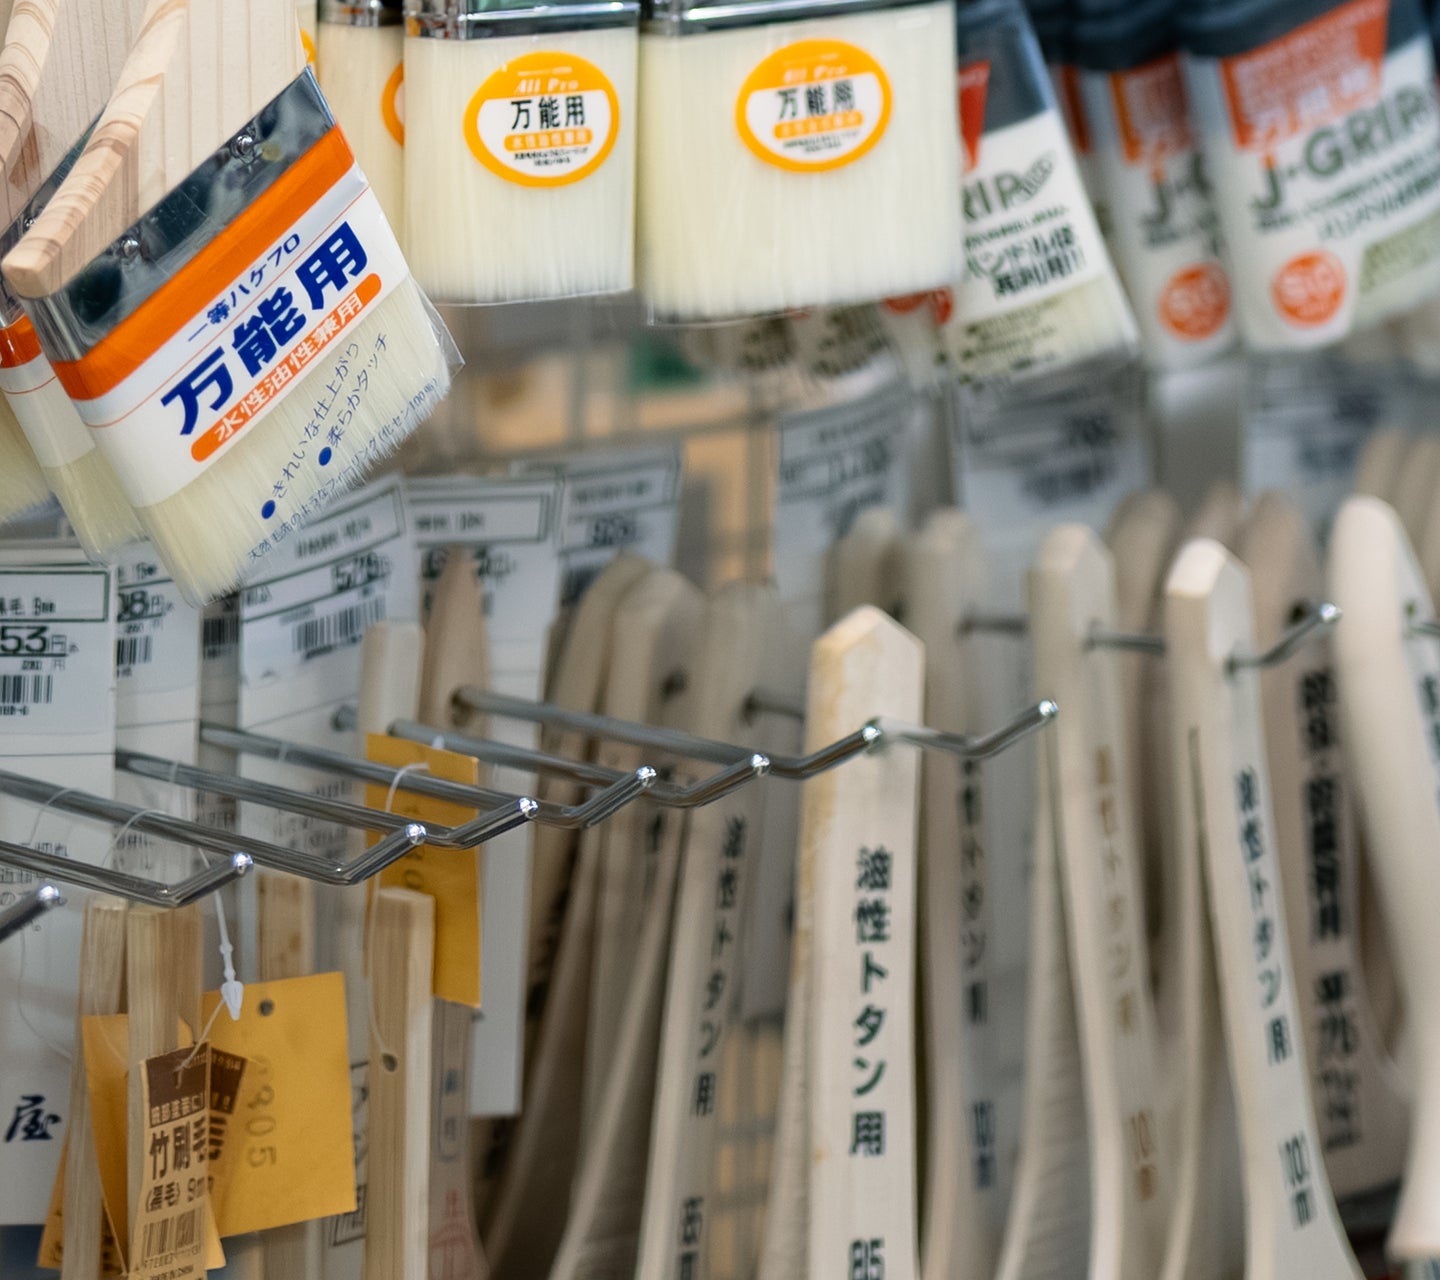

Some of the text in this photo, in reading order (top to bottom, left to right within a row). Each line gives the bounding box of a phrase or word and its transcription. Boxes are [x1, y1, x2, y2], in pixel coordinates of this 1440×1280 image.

[511, 95, 587, 131] 万能用
[160, 221, 369, 437] 万能用
[187, 233, 302, 342] 一等ハケ70
[214, 291, 365, 440] 水性油性兼用
[271, 342, 360, 500] きれいな仕上がり
[328, 331, 389, 449] 柔らかタッチ
[850, 846, 893, 1158] 油性トタン用
